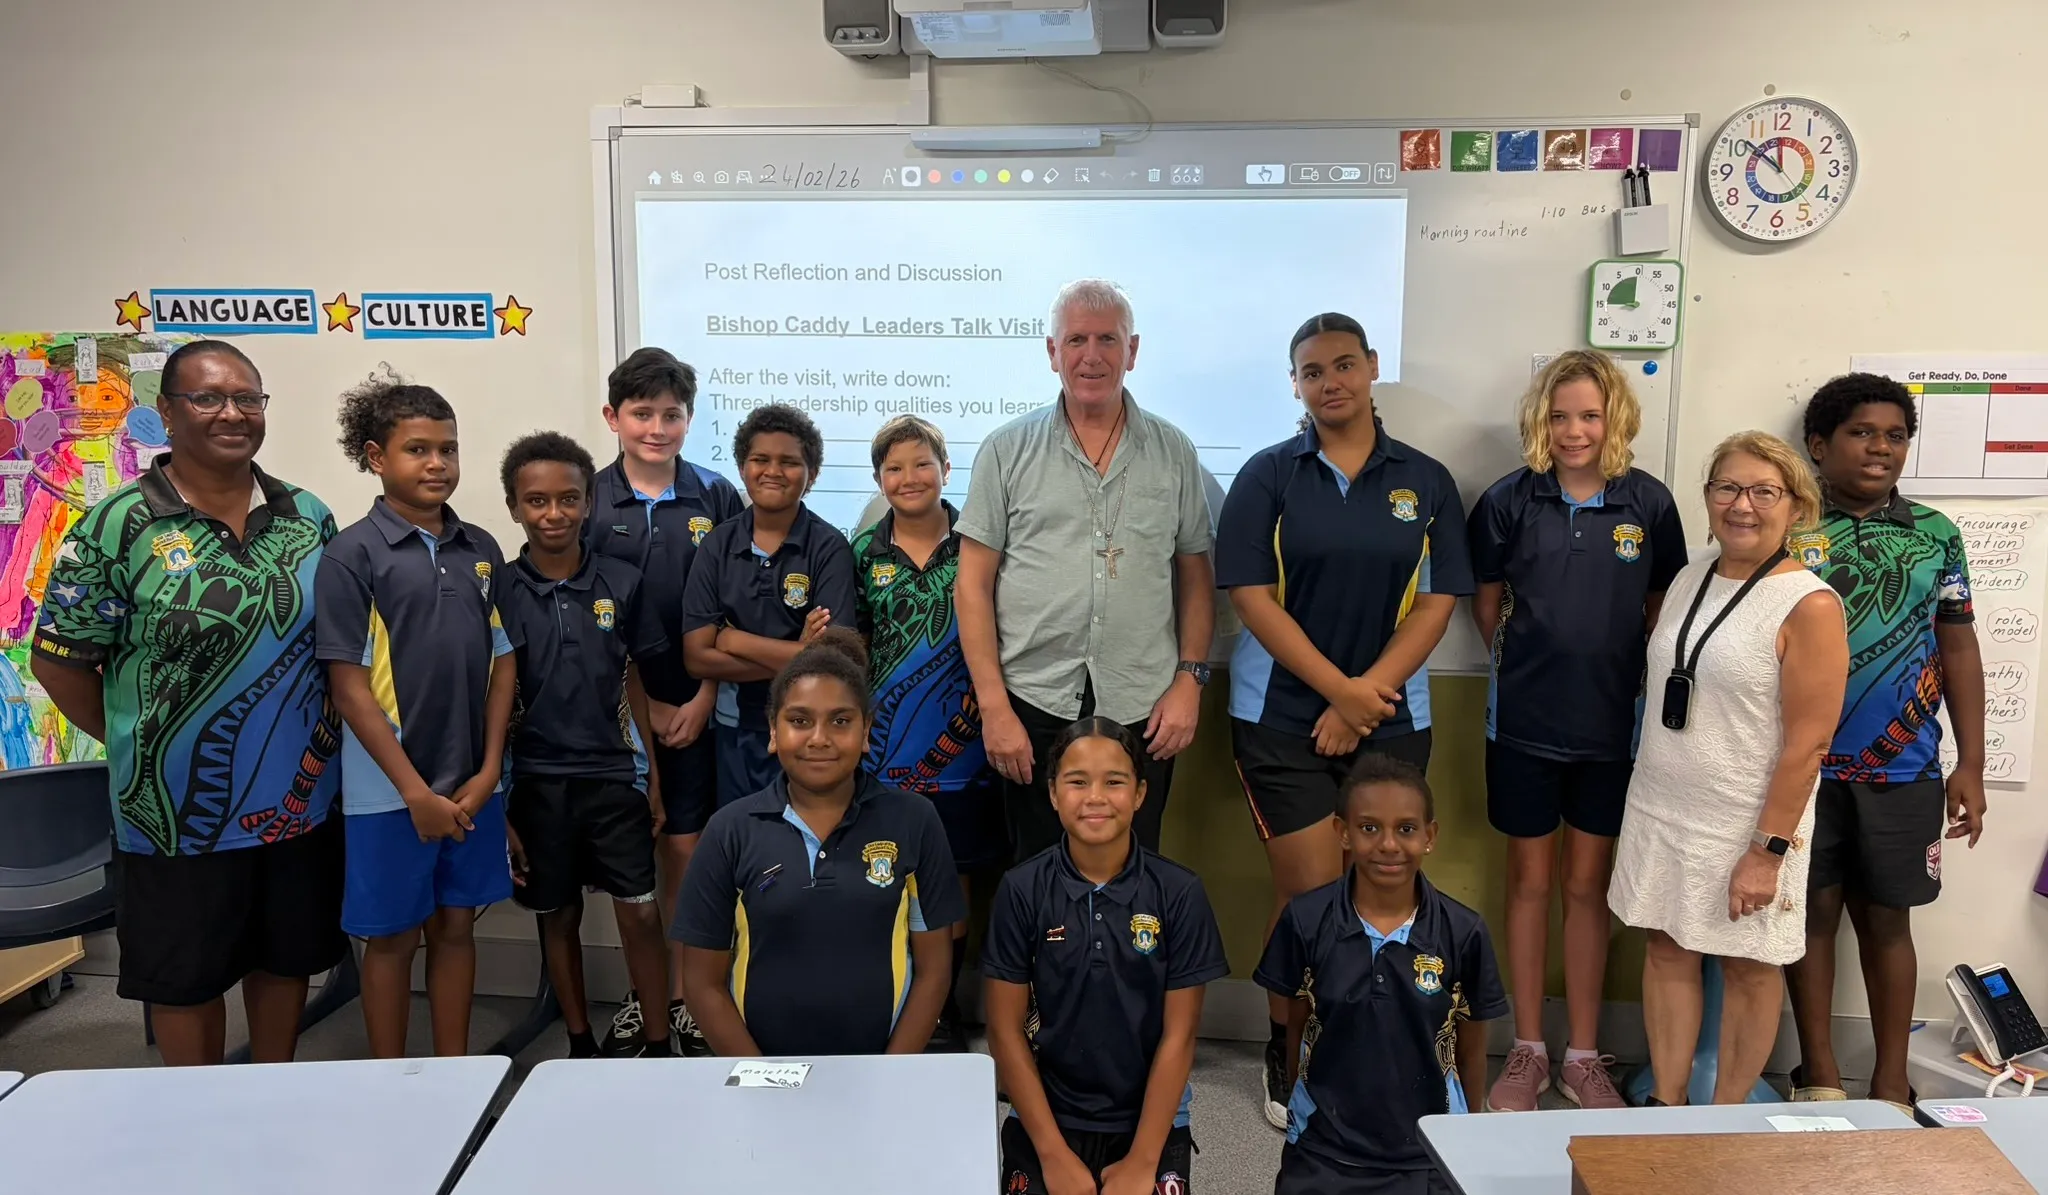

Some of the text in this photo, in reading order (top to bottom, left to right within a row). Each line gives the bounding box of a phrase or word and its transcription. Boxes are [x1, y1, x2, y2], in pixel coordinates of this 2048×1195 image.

[1750, 120, 1764, 138] 11
[1774, 112, 1791, 131] 12
[1807, 118, 1812, 136] 1
[1729, 139, 1747, 157] 10
[1820, 136, 1832, 154] 2
[759, 162, 861, 189] 24/02/26
[1720, 163, 1733, 182] 9
[1828, 159, 1840, 178] 3
[1726, 187, 1739, 206] 8
[1815, 184, 1829, 201] 4
[1746, 205, 1759, 222] 7
[1770, 210, 1783, 228] 6
[1796, 203, 1810, 221] 5
[1420, 220, 1528, 243] Morning routine
[705, 263, 1002, 282] Post Reflection and Discussion
[1616, 271, 1622, 279] 5
[1635, 267, 1641, 275] 0
[1664, 284, 1674, 292] 50
[156, 298, 311, 324] LANGUAGE
[367, 303, 486, 328] CULTURE
[706, 315, 1045, 338] Bishop Caddy Leaders Talk Visit
[1598, 318, 1608, 326] 20
[1628, 334, 1638, 342] 30
[708, 368, 951, 389] After the visit, write down:
[1908, 371, 2008, 381] Get Ready, Do, Done
[709, 393, 764, 411] Three
[875, 396, 953, 417] qualities
[959, 400, 993, 418] you
[711, 419, 727, 436] 1.
[711, 446, 728, 462] 2.
[0, 460, 32, 470] oulders
[1955, 515, 2028, 534] Encourage
[1963, 534, 2017, 549] cation
[1969, 553, 2012, 566] ement
[1970, 573, 2023, 587] nfident
[1995, 614, 2023, 625] role
[1992, 625, 2034, 636] model
[40, 638, 58, 654] WILL
[57, 645, 70, 658] BE
[1982, 665, 2023, 691] pathy
[2005, 696, 2018, 705] to
[1985, 704, 2018, 717] thers
[1986, 737, 2000, 747] ve
